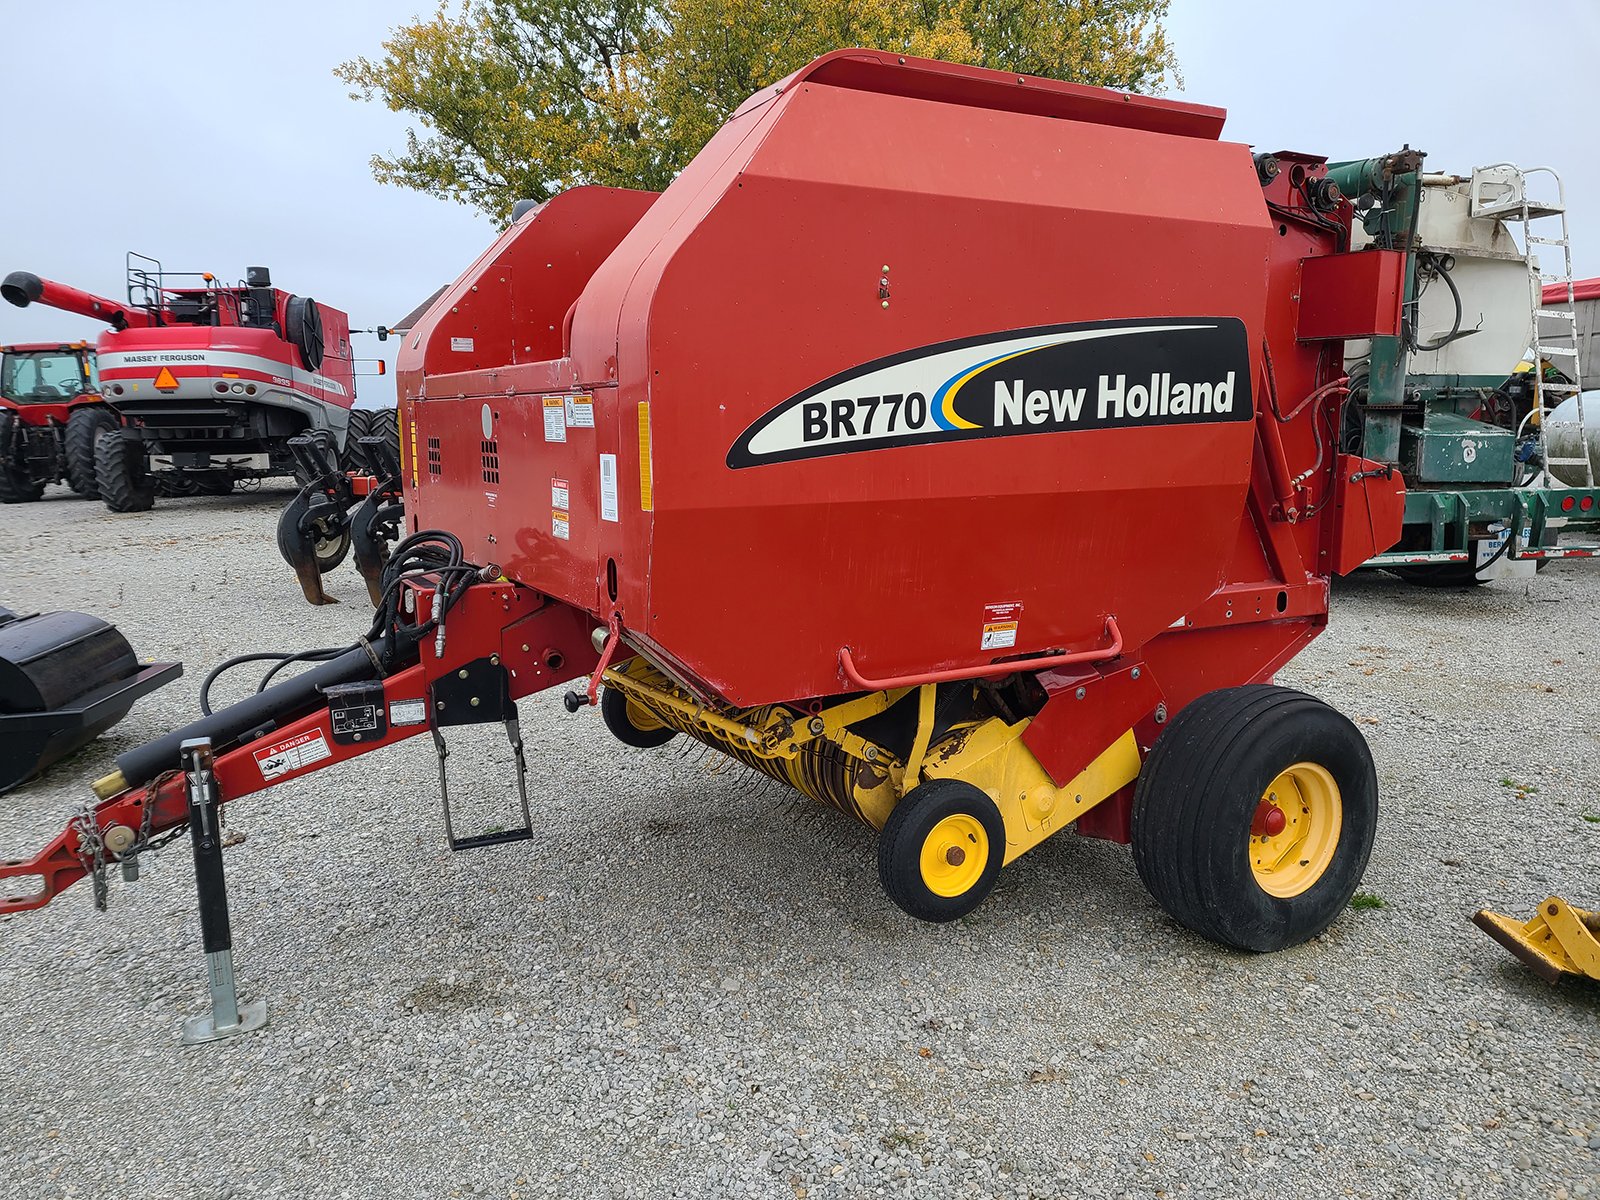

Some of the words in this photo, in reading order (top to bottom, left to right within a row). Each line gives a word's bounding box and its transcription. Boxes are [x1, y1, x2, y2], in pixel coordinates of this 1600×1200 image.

[802, 391, 927, 442] BR770
[993, 379, 1087, 427] New
[1097, 371, 1236, 419] Holland
[280, 735, 310, 751] DANGER
